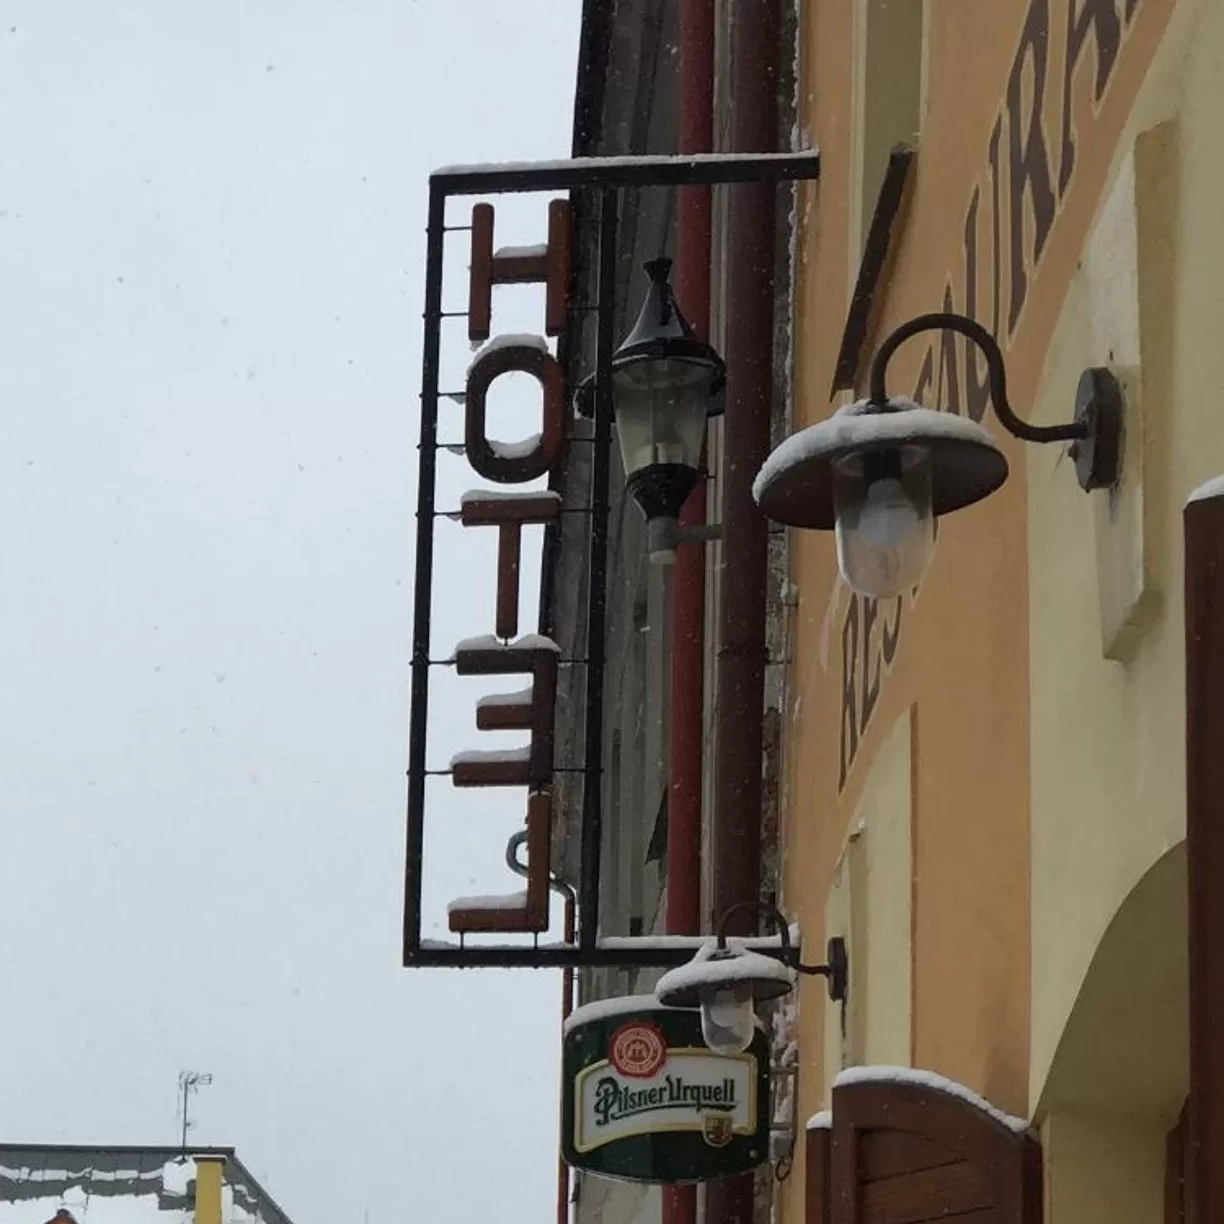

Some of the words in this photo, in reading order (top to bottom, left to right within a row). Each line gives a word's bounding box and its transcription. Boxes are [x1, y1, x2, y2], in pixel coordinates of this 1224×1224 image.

[839, 0, 1138, 796] REAURA
[594, 1076, 667, 1126] Pilsner
[665, 1075, 735, 1112] Urquell
